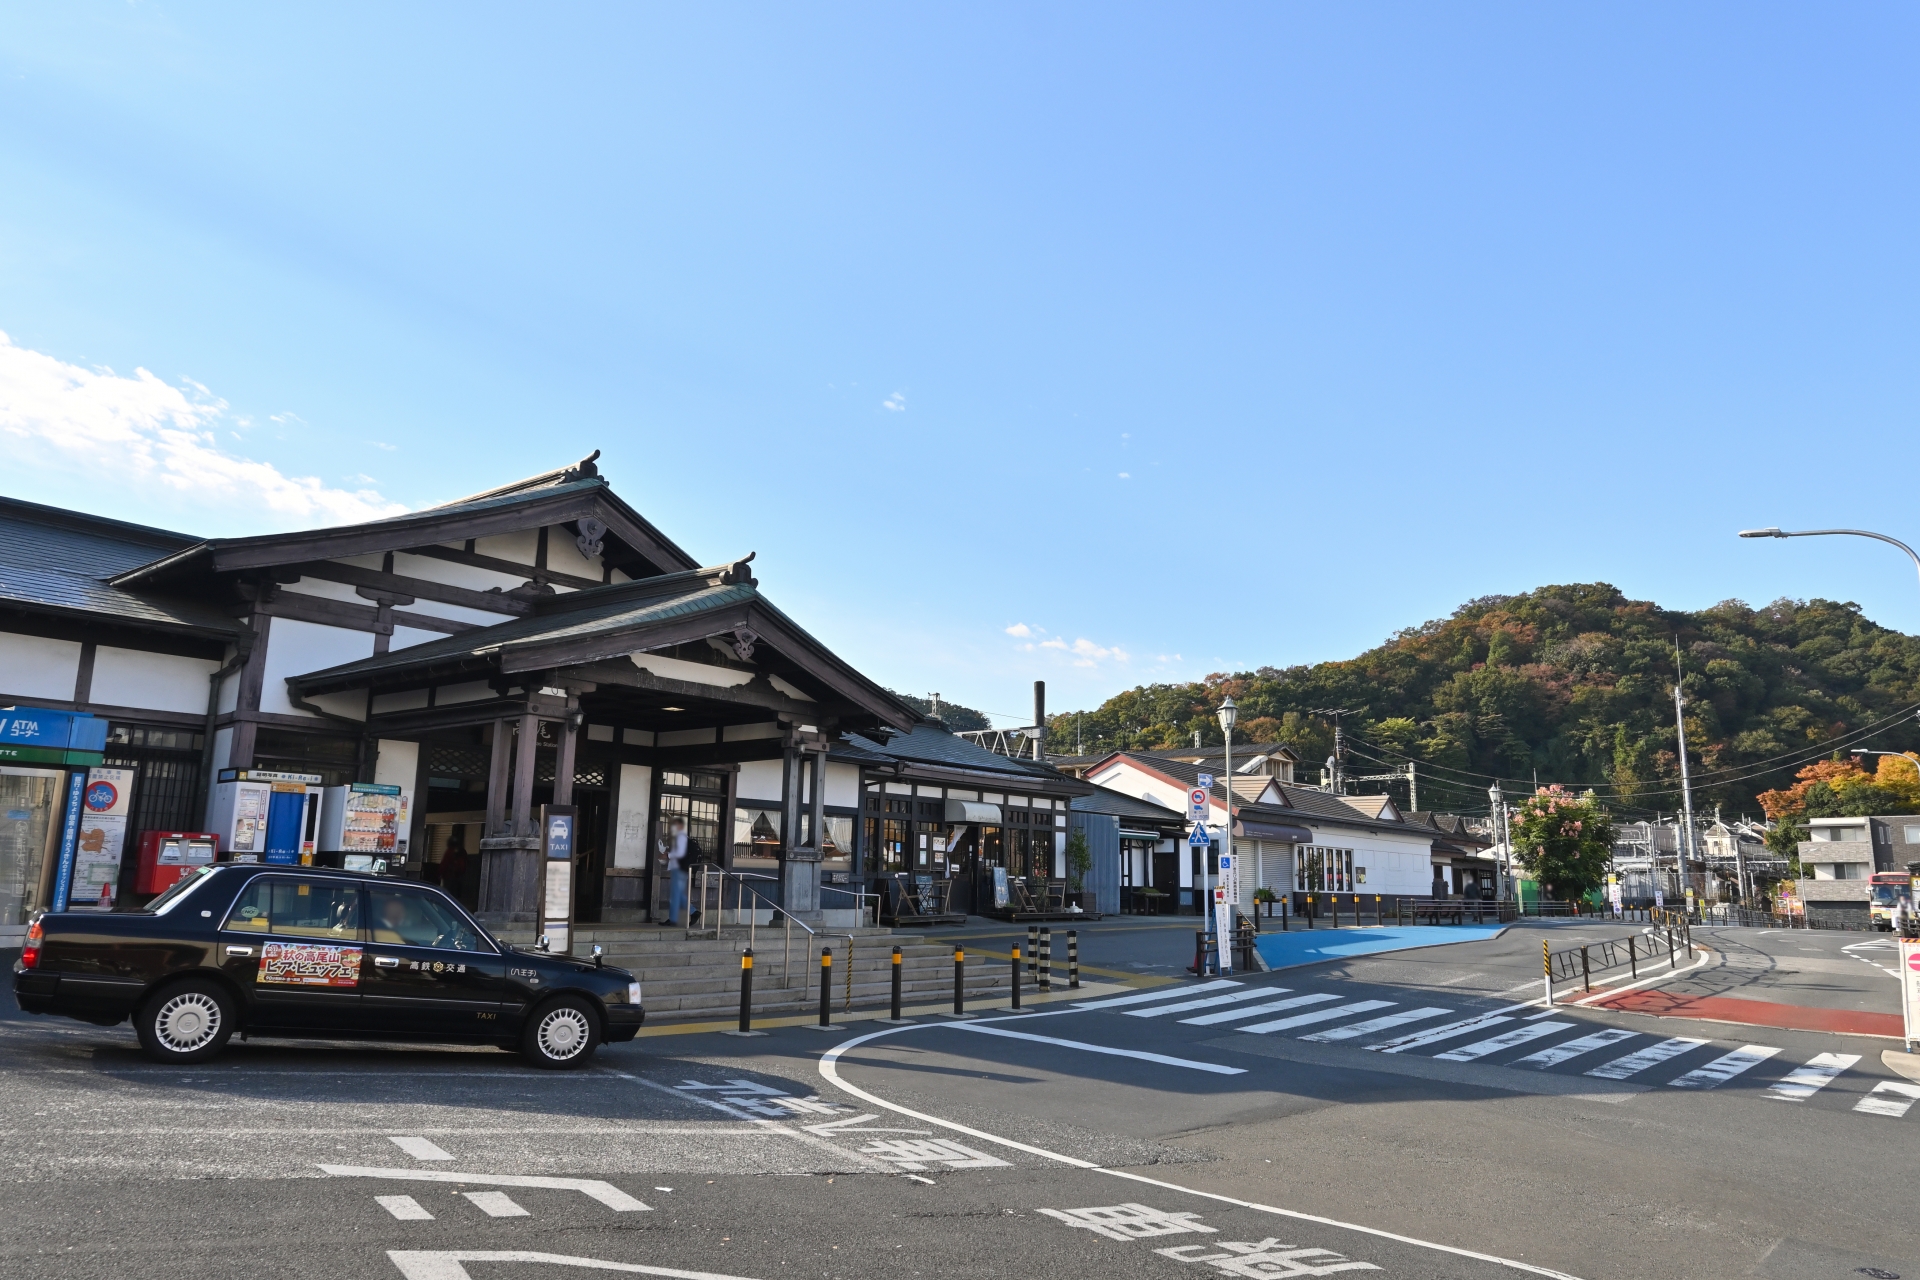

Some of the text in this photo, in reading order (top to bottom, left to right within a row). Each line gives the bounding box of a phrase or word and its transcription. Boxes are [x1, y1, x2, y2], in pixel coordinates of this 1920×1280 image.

[12, 719, 38, 731] ATM
[10, 729, 40, 738] コーナー
[550, 843, 568, 851] TAXI
[283, 949, 341, 963] 秋の高尾山
[265, 960, 352, 977] ビア・ビュッフェ
[409, 961, 466, 973] 高鉄 交通
[510, 968, 537, 977] (八王子)
[476, 1012, 497, 1020] TAXI
